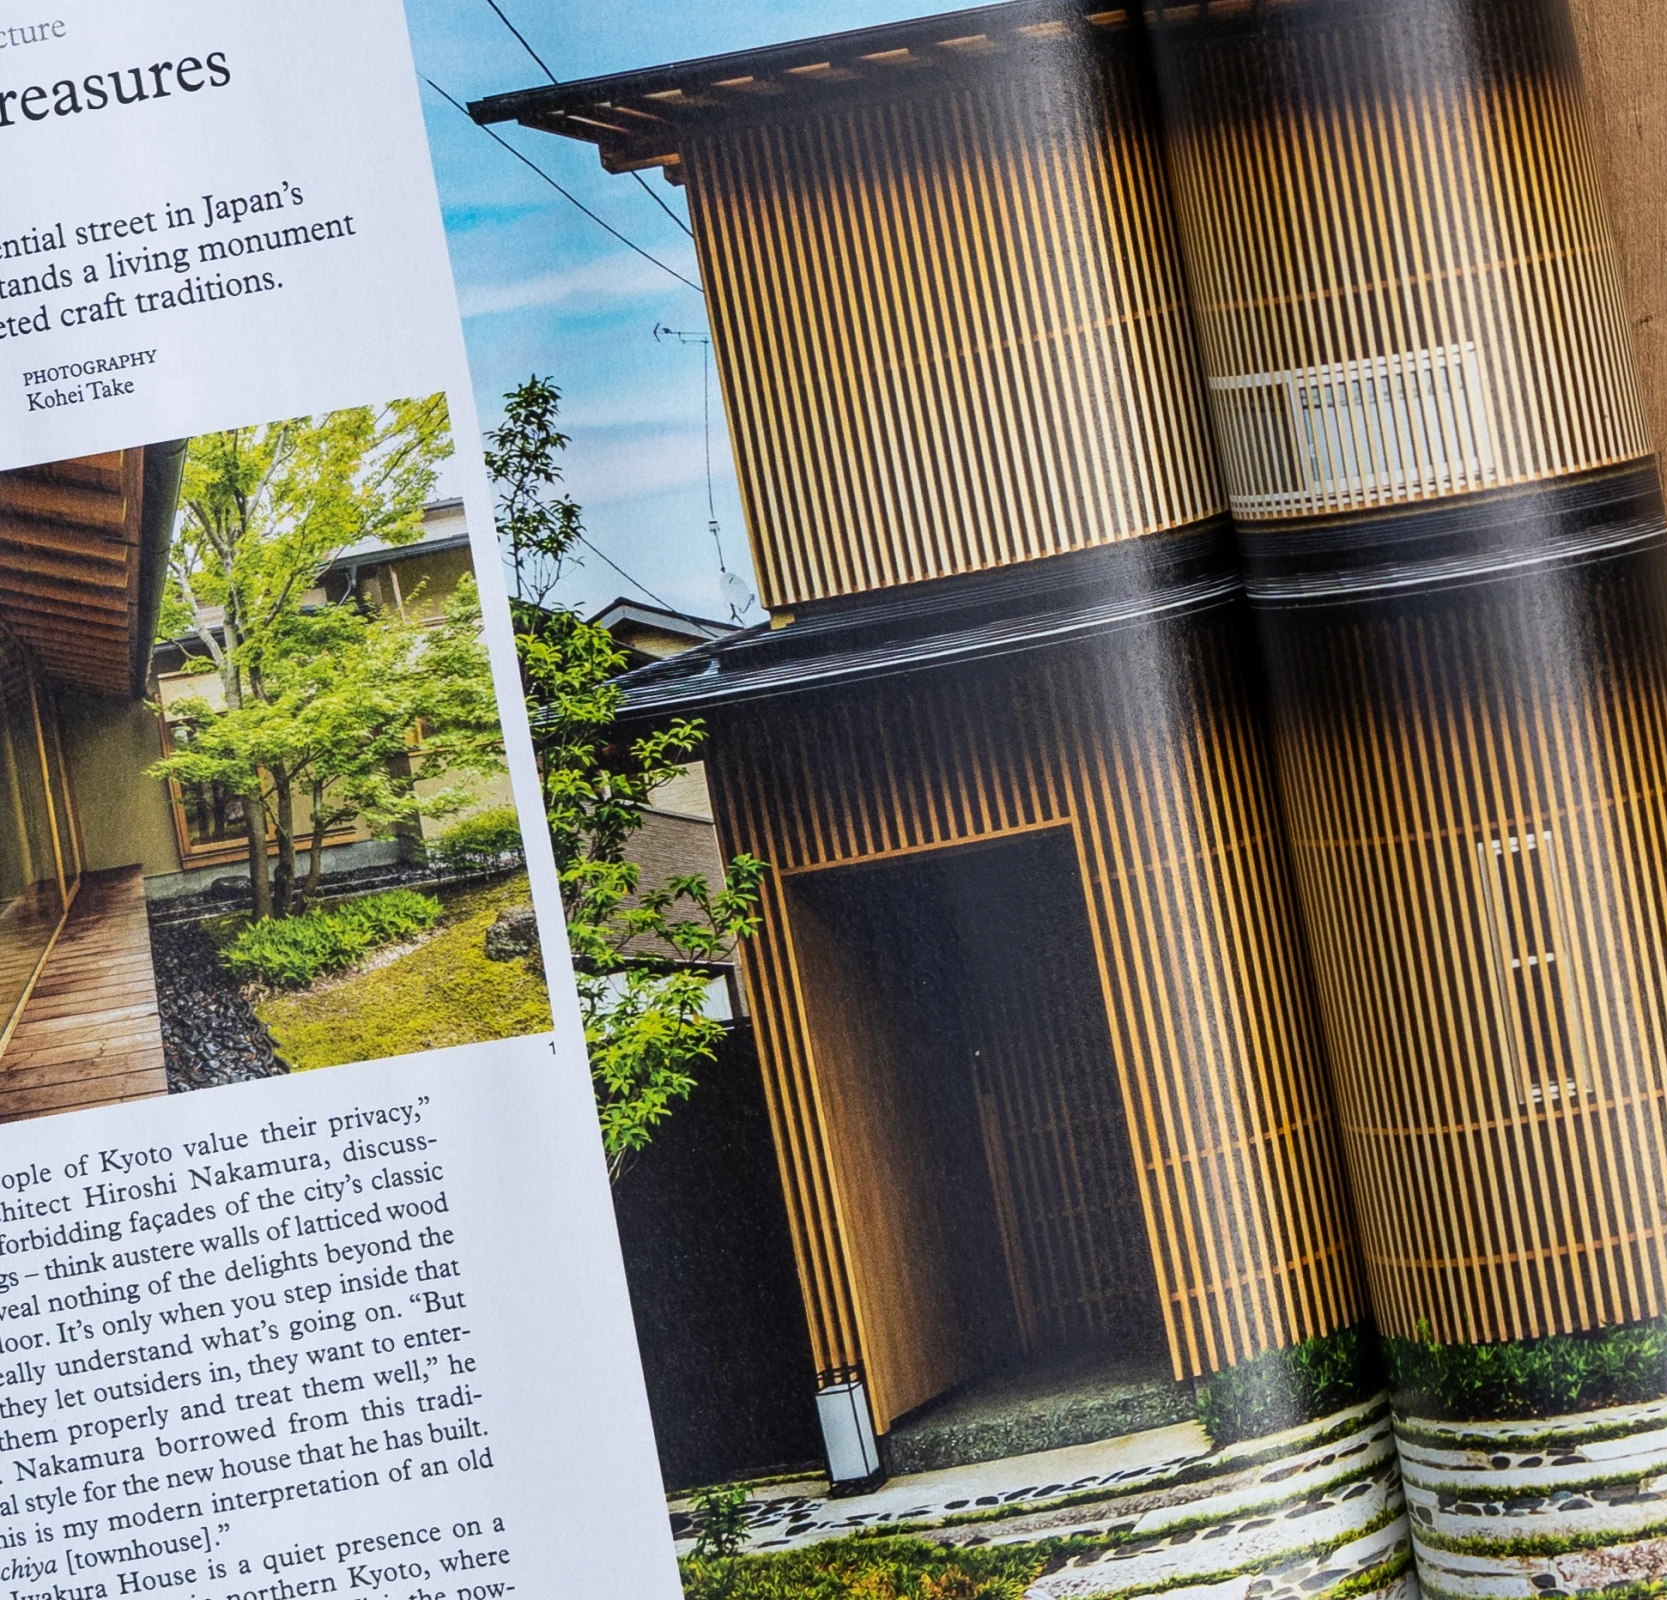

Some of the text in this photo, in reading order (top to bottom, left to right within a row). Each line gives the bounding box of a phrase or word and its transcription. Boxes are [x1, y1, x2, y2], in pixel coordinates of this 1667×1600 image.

[0, 52, 231, 127] reasures
[0, 181, 303, 260] ntial street in Japan’s
[0, 215, 356, 299] tands a living monument
[60, 292, 128, 327] craft
[134, 272, 283, 313] traditions.
[22, 349, 157, 387] PHOTOGRAPHY
[26, 379, 135, 412] Kohei Take
[548, 1041, 556, 1055] 1
[0, 1136, 437, 1222] hitect Hiroshi Nakamura, discuss-
[1, 1096, 429, 1193] ople of Kyoto value their privacy,”
[0, 1161, 443, 1256] forbidding façades of the city’s classic
[44, 1251, 107, 1280] think
[112, 1242, 195, 1269] austere
[199, 1225, 260, 1253] walls
[266, 1217, 291, 1241] of
[294, 1202, 382, 1236] latticed
[386, 1191, 449, 1220] wood
[48, 1282, 141, 1313] nothing
[148, 1271, 172, 1295] of
[177, 1268, 216, 1290] the
[225, 1250, 318, 1282] delights
[324, 1230, 412, 1264] beyond
[418, 1226, 454, 1248] the
[56, 1319, 94, 1344] It’s
[102, 1310, 152, 1336] only
[158, 1301, 225, 1326] when
[230, 1293, 277, 1319] you
[284, 1283, 332, 1304] step
[339, 1265, 408, 1294] inside
[414, 1259, 461, 1281] that
[0, 1327, 471, 1419] they let outsiders in, they want to enter-
[55, 1333, 194, 1376] understand
[201, 1320, 279, 1351] what’s
[289, 1309, 356, 1341] going
[365, 1305, 402, 1322] on.
[409, 1291, 466, 1313] “But
[0, 1354, 476, 1452] them properly and treat them well,” he
[12, 1384, 482, 1482] Nakamura borrowed from this tradi-
[0, 1416, 488, 1516] al style for the new house that he has built.
[35, 1522, 54, 1543] is
[62, 1519, 98, 1540] my
[107, 1502, 204, 1531] modern
[212, 1470, 380, 1514] interpretation
[389, 1458, 412, 1482] of
[420, 1460, 449, 1478] an
[457, 1447, 494, 1472] old
[0, 1523, 230, 1582] chiya [townhouse].”
[116, 1569, 197, 1595] House
[208, 1559, 227, 1580] is
[238, 1559, 252, 1575] a
[263, 1543, 326, 1574] quiet
[335, 1527, 441, 1563] presence
[453, 1521, 483, 1538] on
[493, 1517, 505, 1532] a
[347, 1563, 430, 1590] Kyoto,
[439, 1549, 510, 1573] where
